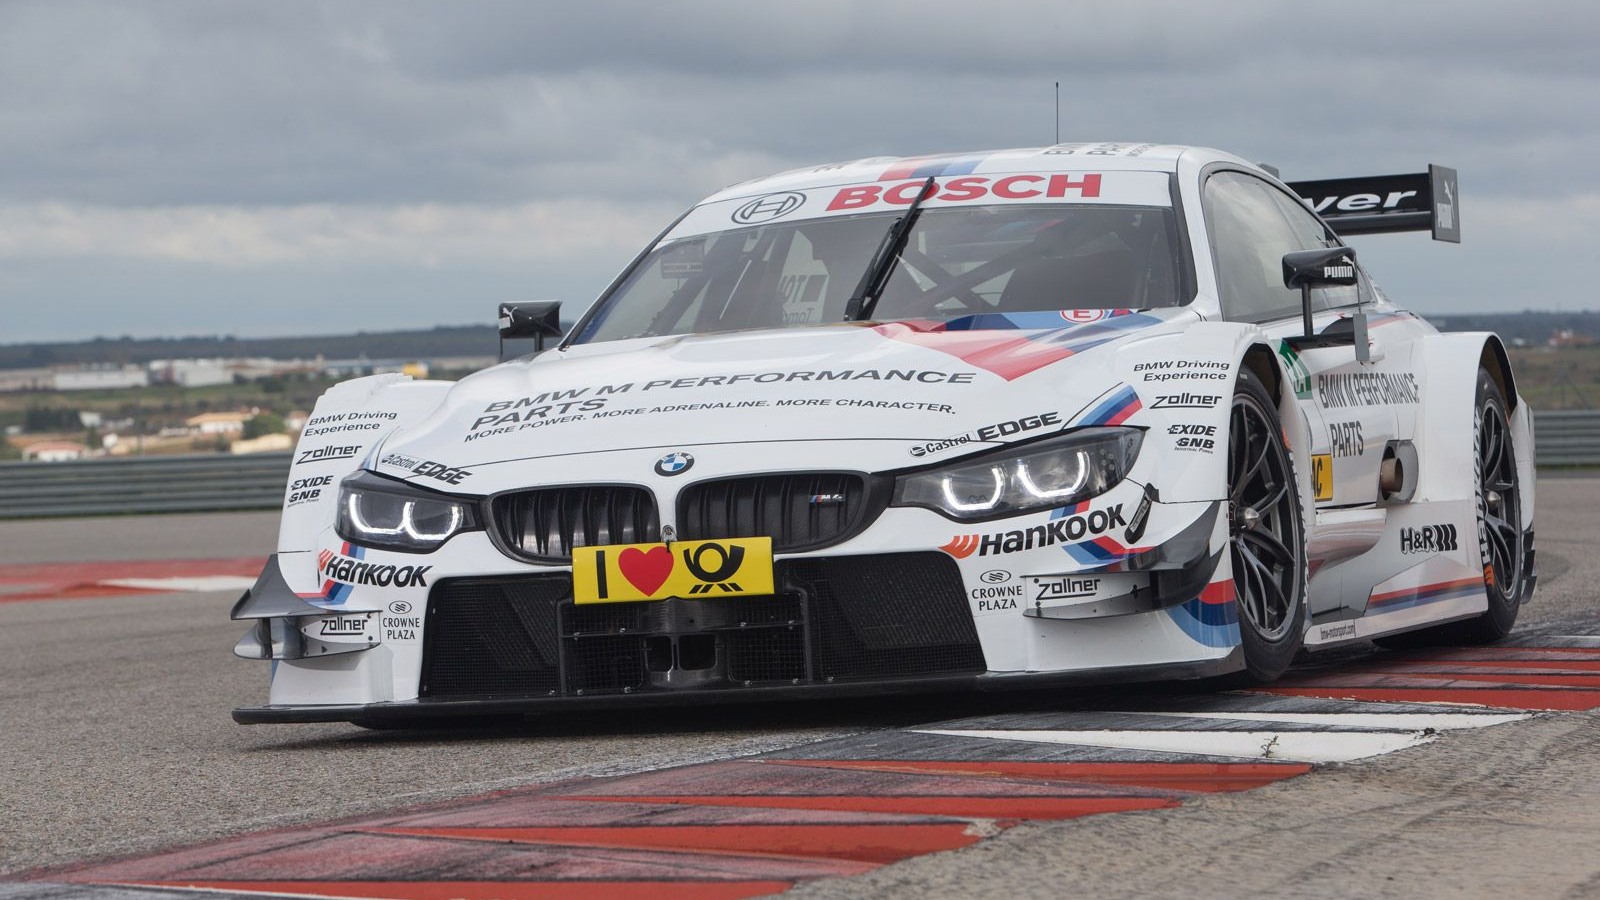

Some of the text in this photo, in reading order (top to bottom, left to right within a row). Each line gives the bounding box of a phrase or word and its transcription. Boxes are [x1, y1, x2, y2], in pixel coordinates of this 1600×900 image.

[825, 173, 1102, 211] BOSCH
[1324, 265, 1353, 278] PUMA
[1134, 360, 1230, 371] BMW Driving
[1143, 371, 1227, 382] Experience
[484, 370, 977, 413] BMW M PERFORMANCE
[1319, 374, 1347, 409] BMW
[1353, 371, 1420, 406] PERFORMANCE
[1149, 393, 1222, 409] zollner
[309, 411, 398, 426] BMW Driving
[464, 426, 515, 443] MORE
[519, 414, 587, 431] POWER.
[592, 407, 647, 419] MORE
[649, 400, 771, 414] ADRENALINE.
[835, 399, 957, 415] CHARACTER.
[470, 398, 609, 431] PARTS
[304, 423, 381, 437] Experience
[926, 412, 1063, 453] Castrol EDGE
[1167, 424, 1217, 437] EXIDE
[1329, 421, 1364, 458] PARTS
[296, 445, 362, 465] zollner
[290, 475, 334, 491] EXIDE
[411, 460, 473, 486] EDGE
[1400, 527, 1434, 552] H&R
[596, 550, 608, 599] I
[971, 586, 1023, 599] CROWNE
[1036, 578, 1101, 600] zollner
[979, 599, 1017, 611] PLAZA
[320, 616, 368, 636] zollner
[382, 617, 420, 628] CROWNE
[387, 629, 416, 640] PLAZA
